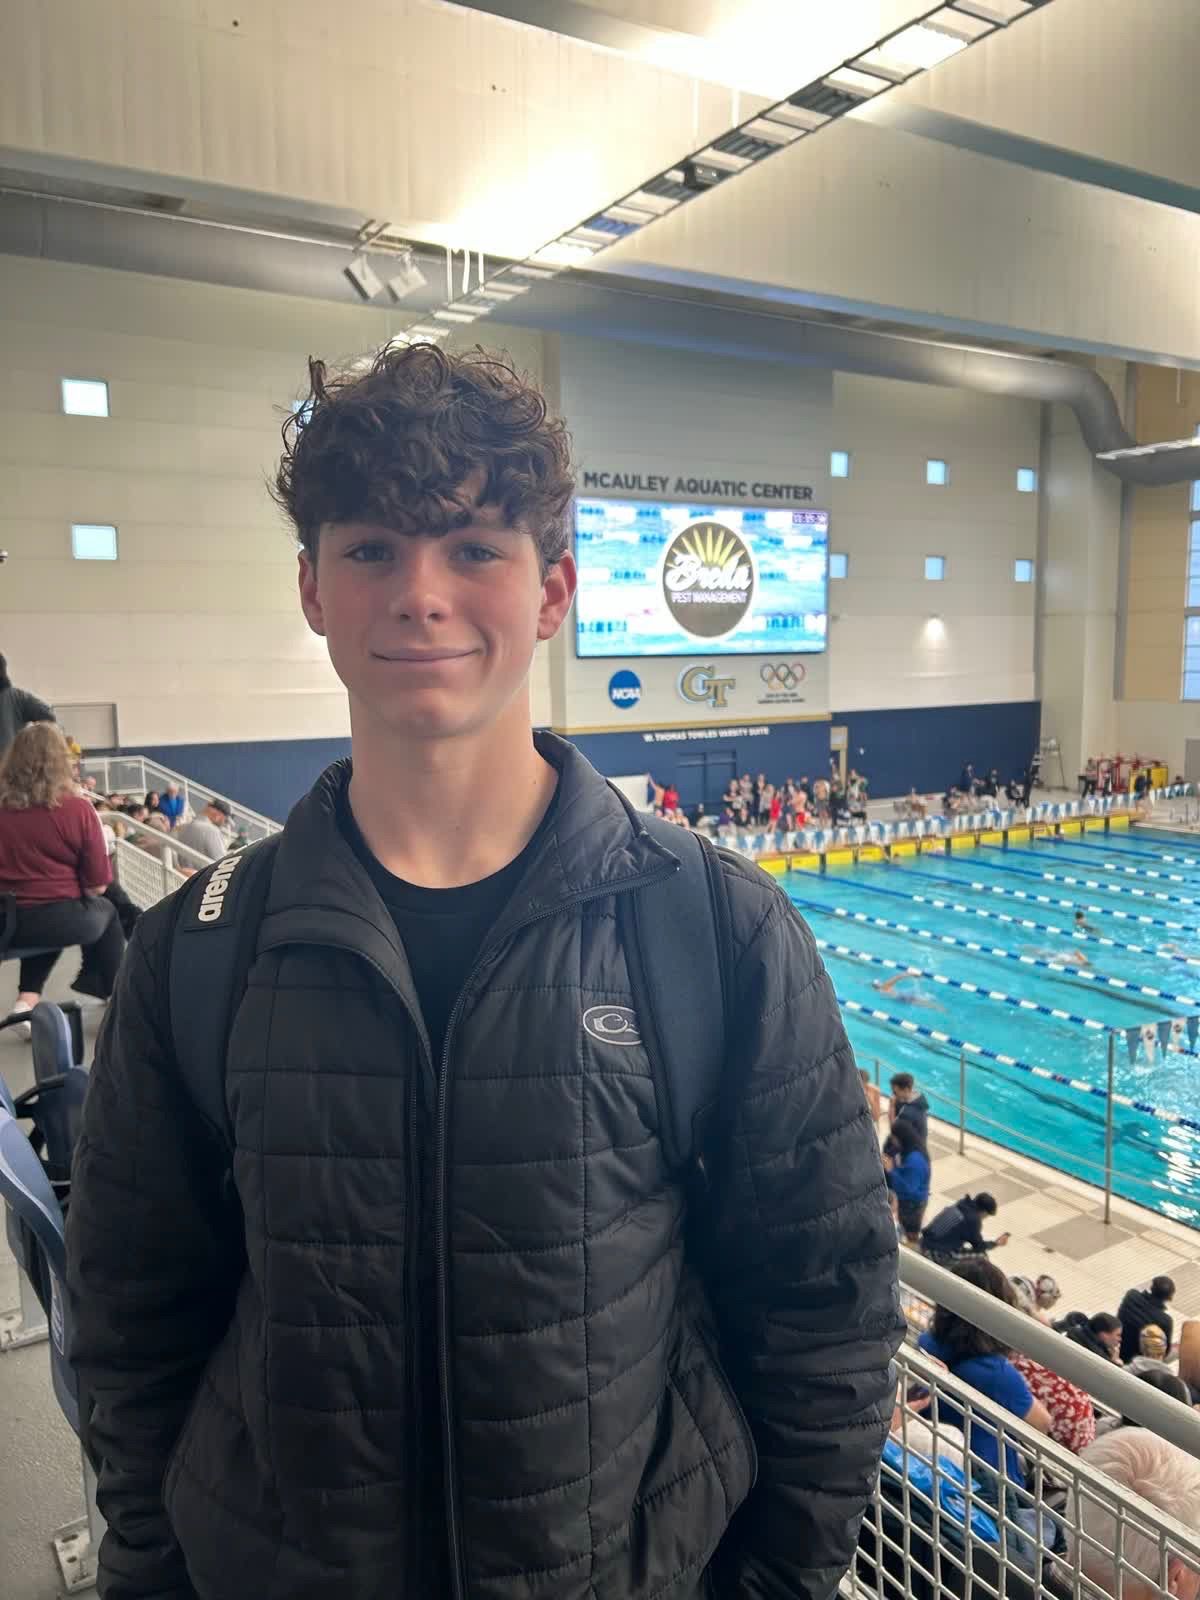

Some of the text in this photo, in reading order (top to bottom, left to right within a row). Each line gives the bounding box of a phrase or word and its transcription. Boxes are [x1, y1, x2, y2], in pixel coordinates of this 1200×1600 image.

[583, 471, 814, 501] MCAULEY AQUATIC CENTER
[672, 591, 748, 603] PEST MANAGEMENT
[612, 687, 641, 699] NCAA
[678, 664, 737, 708] GT
[655, 731, 686, 741] THOMAS
[749, 727, 769, 735] SUITE
[198, 855, 243, 922] arena
